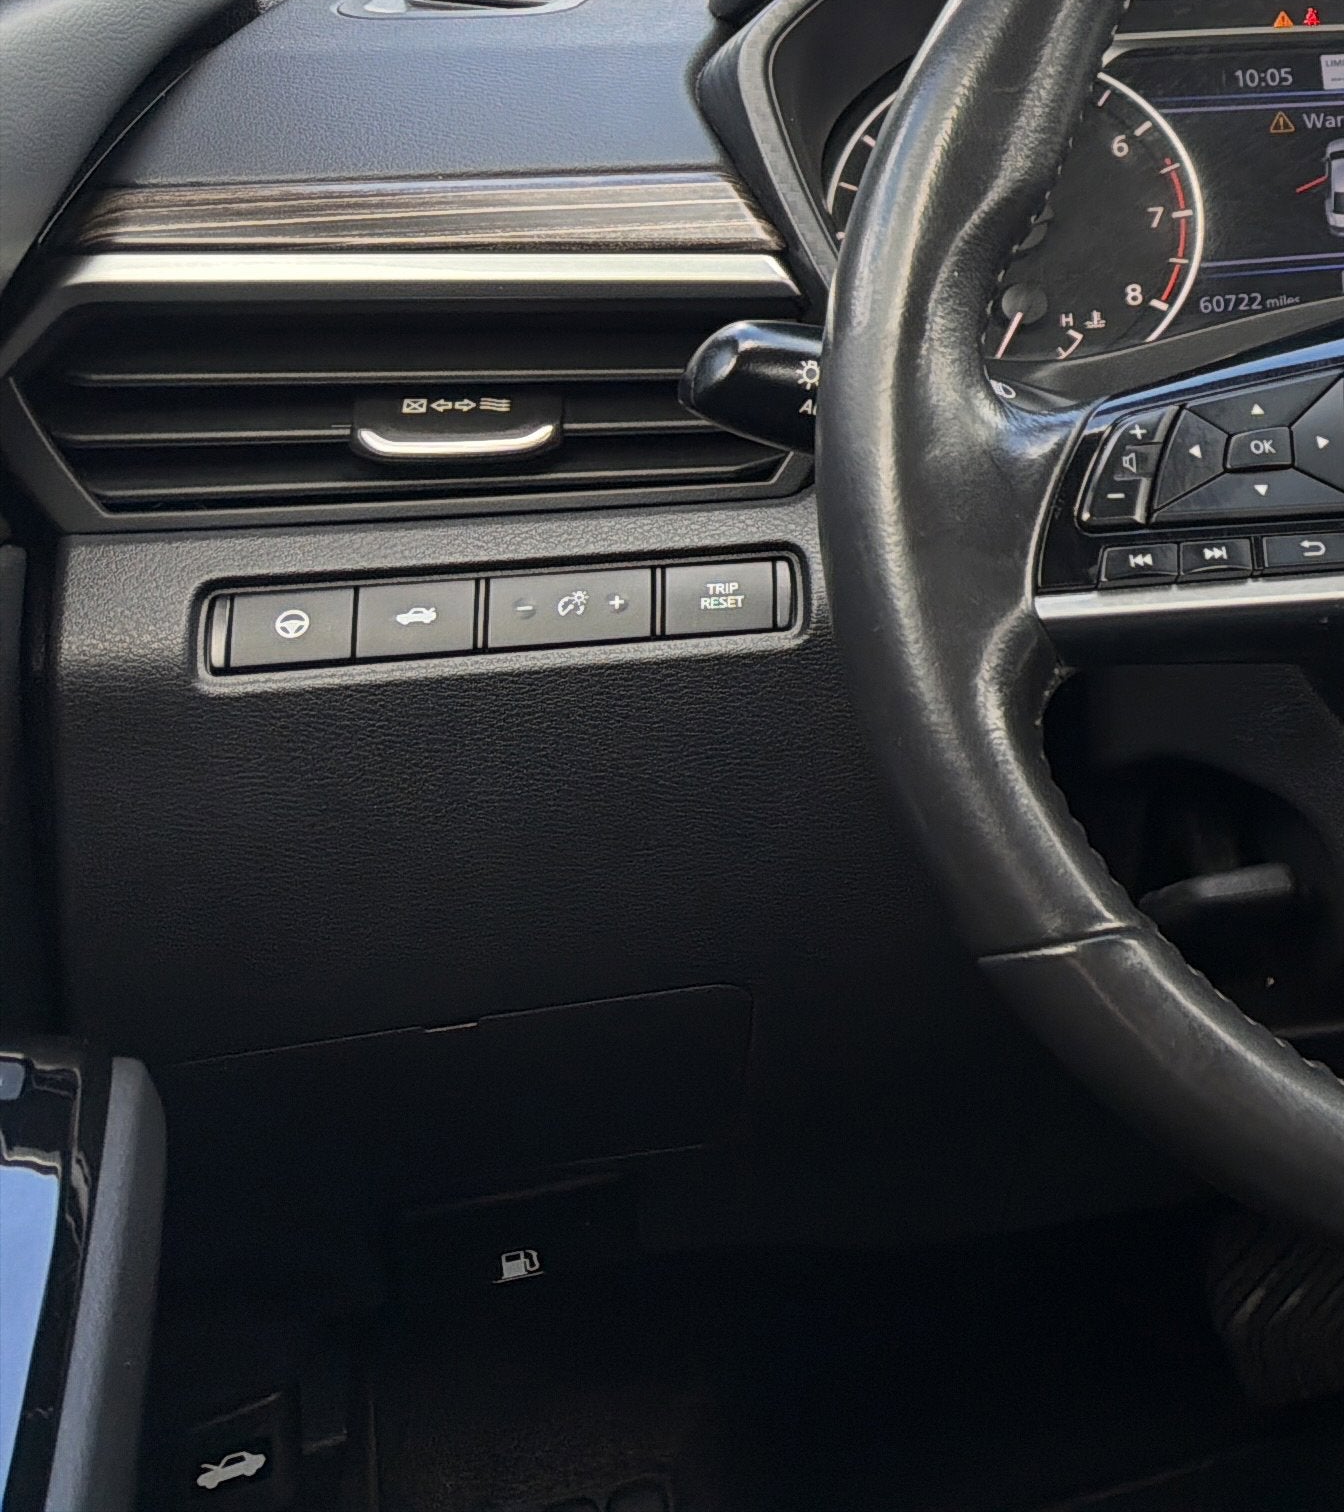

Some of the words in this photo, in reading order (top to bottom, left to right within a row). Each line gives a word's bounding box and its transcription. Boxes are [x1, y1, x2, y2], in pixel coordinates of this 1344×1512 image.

[1234, 67, 1293, 88] 10:05
[1110, 135, 1129, 158] 6
[1147, 207, 1164, 228] 7
[1125, 284, 1143, 306] 8
[1200, 293, 1263, 314] 60722
[1060, 313, 1073, 328] H
[1249, 439, 1277, 455] OK
[706, 581, 740, 597] TRIP
[700, 593, 745, 610] RESET
